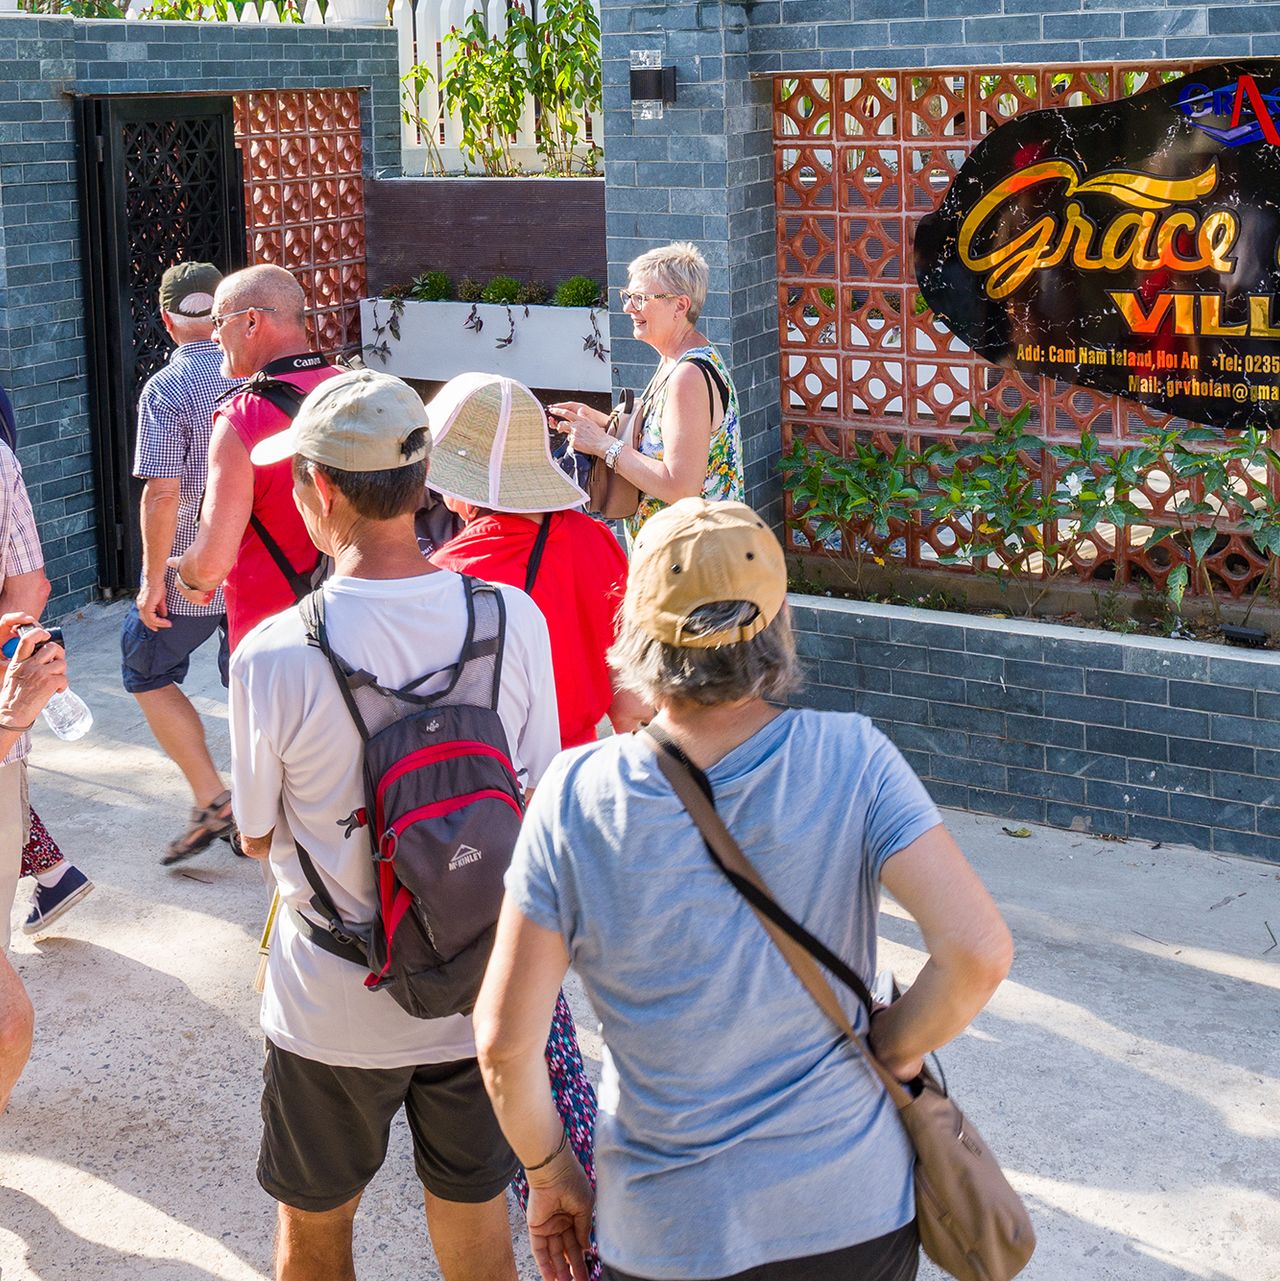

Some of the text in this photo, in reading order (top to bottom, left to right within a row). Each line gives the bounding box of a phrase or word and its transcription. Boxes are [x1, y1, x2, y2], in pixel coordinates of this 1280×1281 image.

[957, 160, 1239, 300] Grace
[1016, 344, 1045, 362] Add:
[1049, 345, 1076, 363] Cam
[1079, 347, 1107, 365] Nam
[1181, 351, 1199, 370] An
[1245, 355, 1280, 374] 0235
[1128, 375, 1162, 394] Mail:
